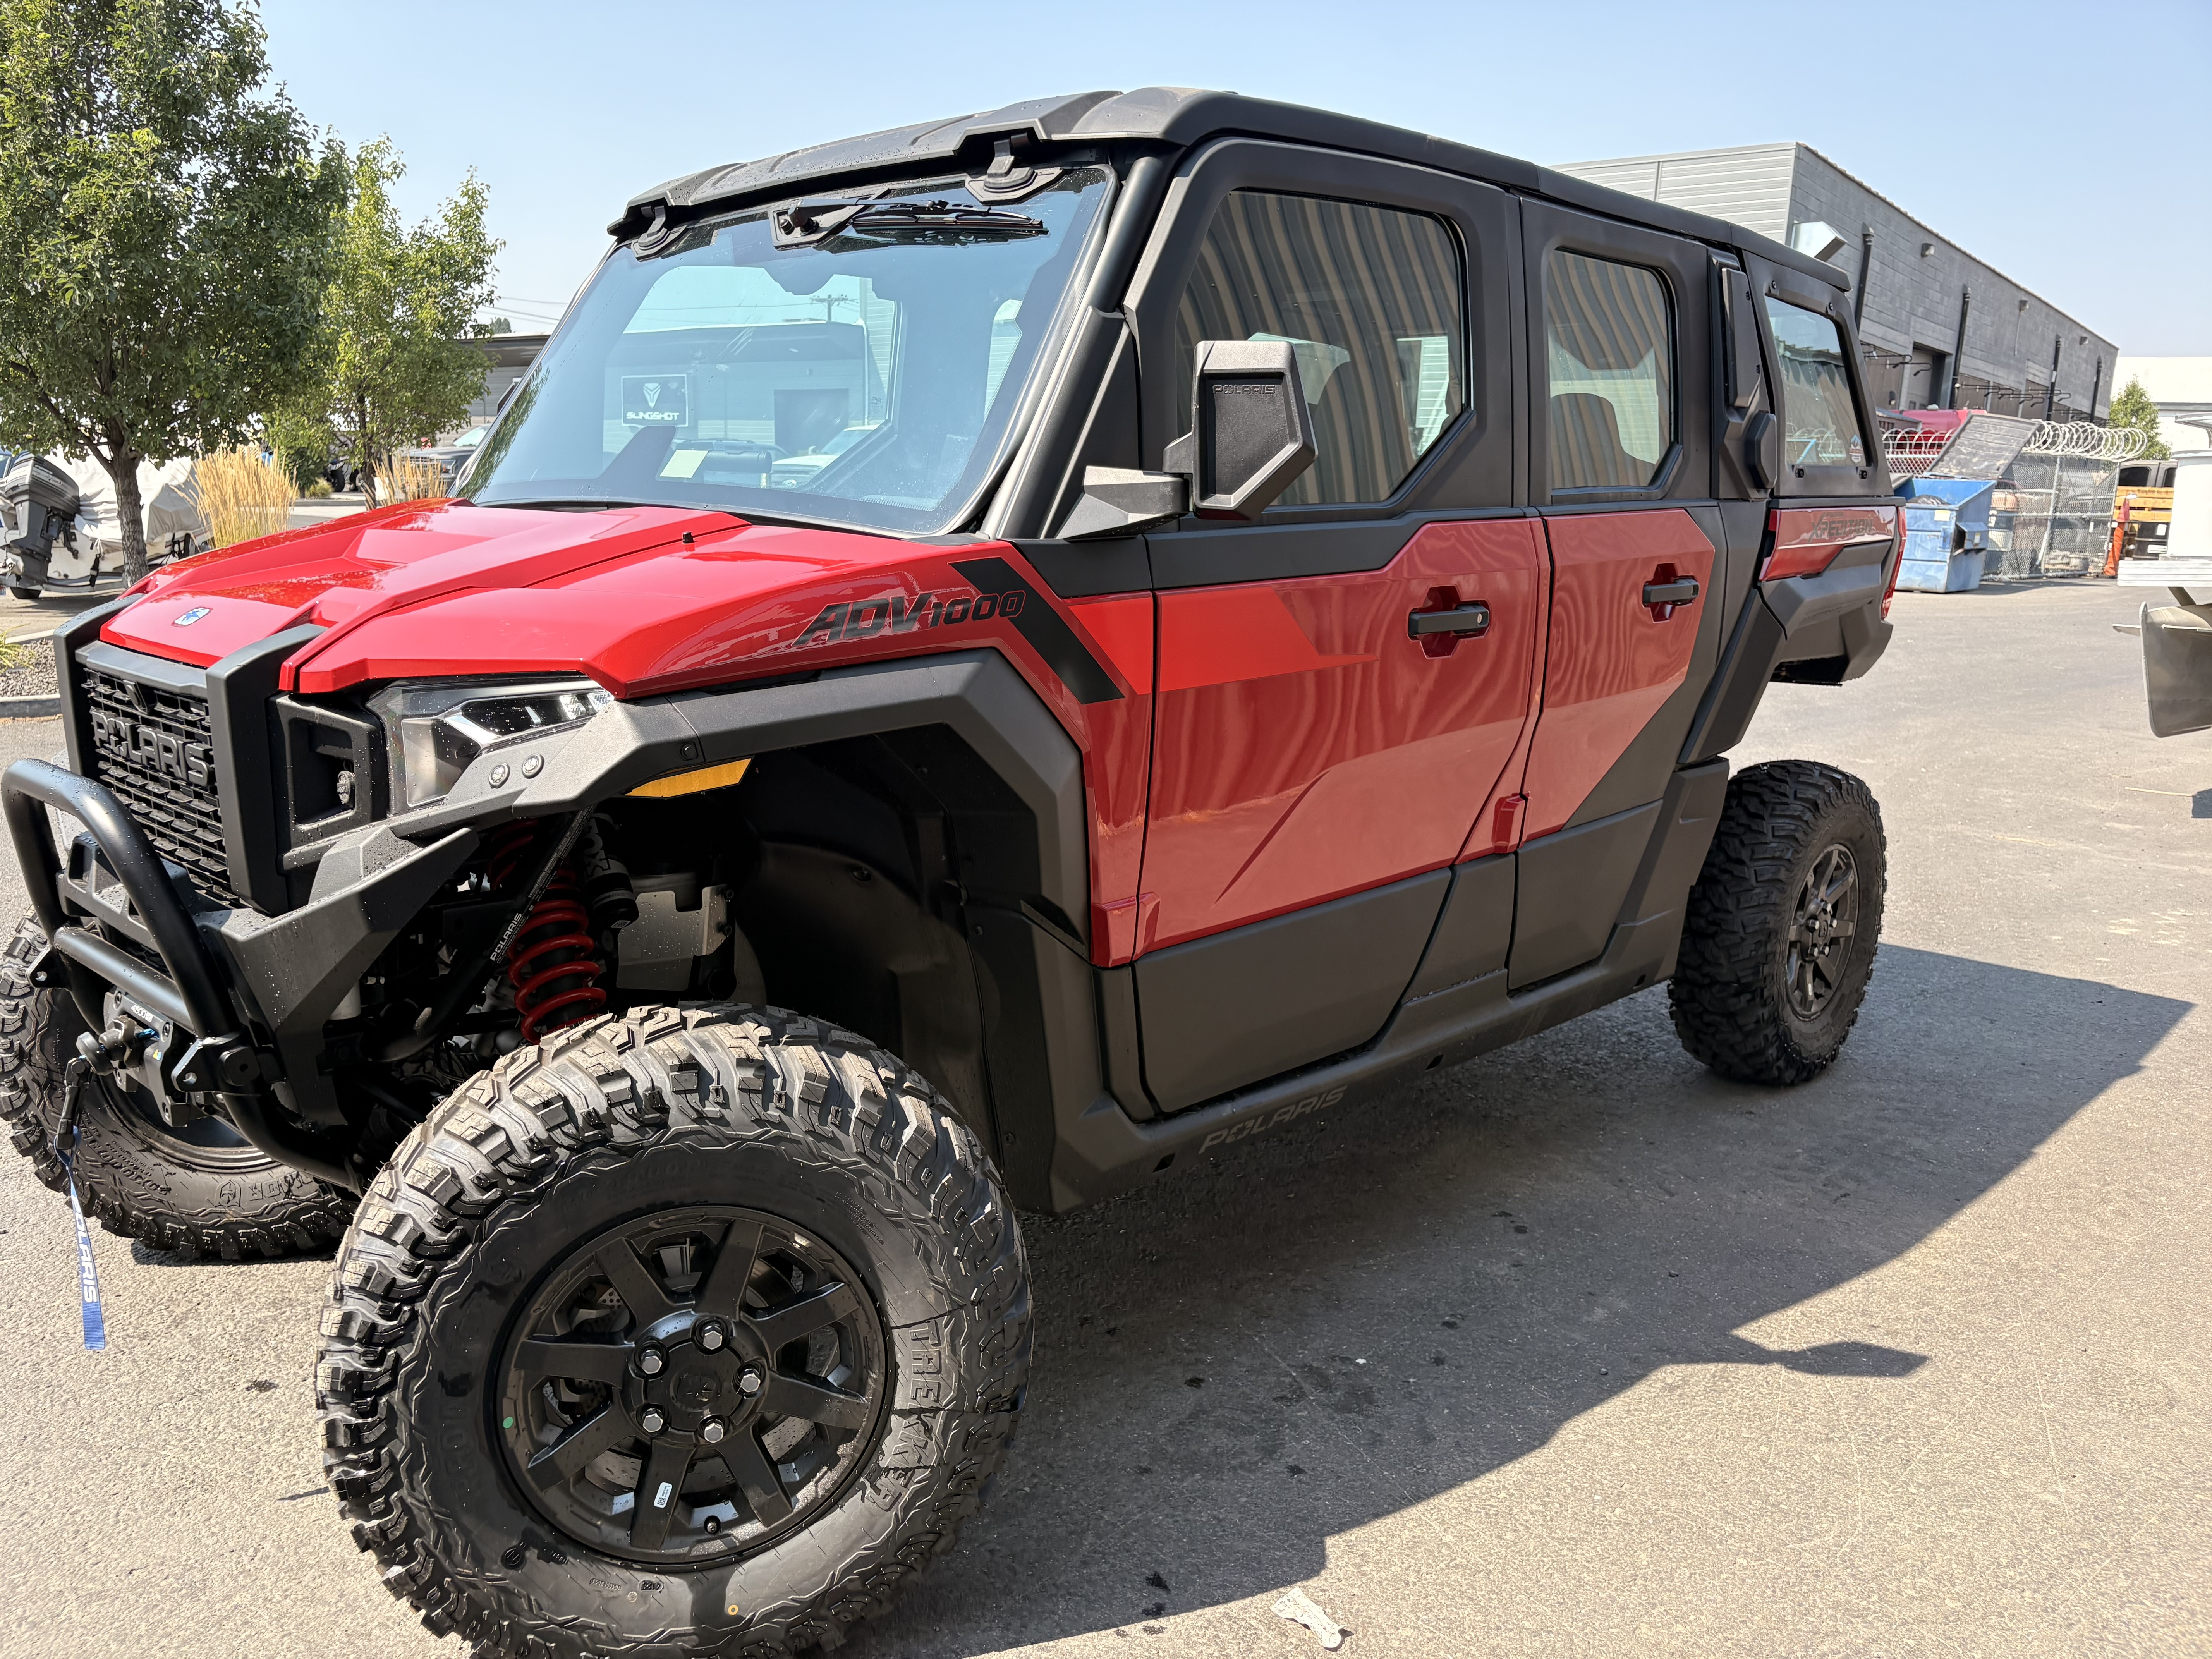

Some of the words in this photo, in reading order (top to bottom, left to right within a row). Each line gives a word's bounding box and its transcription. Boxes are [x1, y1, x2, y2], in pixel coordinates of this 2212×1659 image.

[1212, 385, 1275, 394] POLARIS
[626, 412, 679, 420] SLINGSHOT
[1808, 512, 1874, 544] XPEDITION
[89, 710, 210, 787] POLARIS
[489, 913, 522, 961] POLARIS
[1199, 1085, 1348, 1154] POLARIS
[71, 1195, 97, 1303] POLARIS
